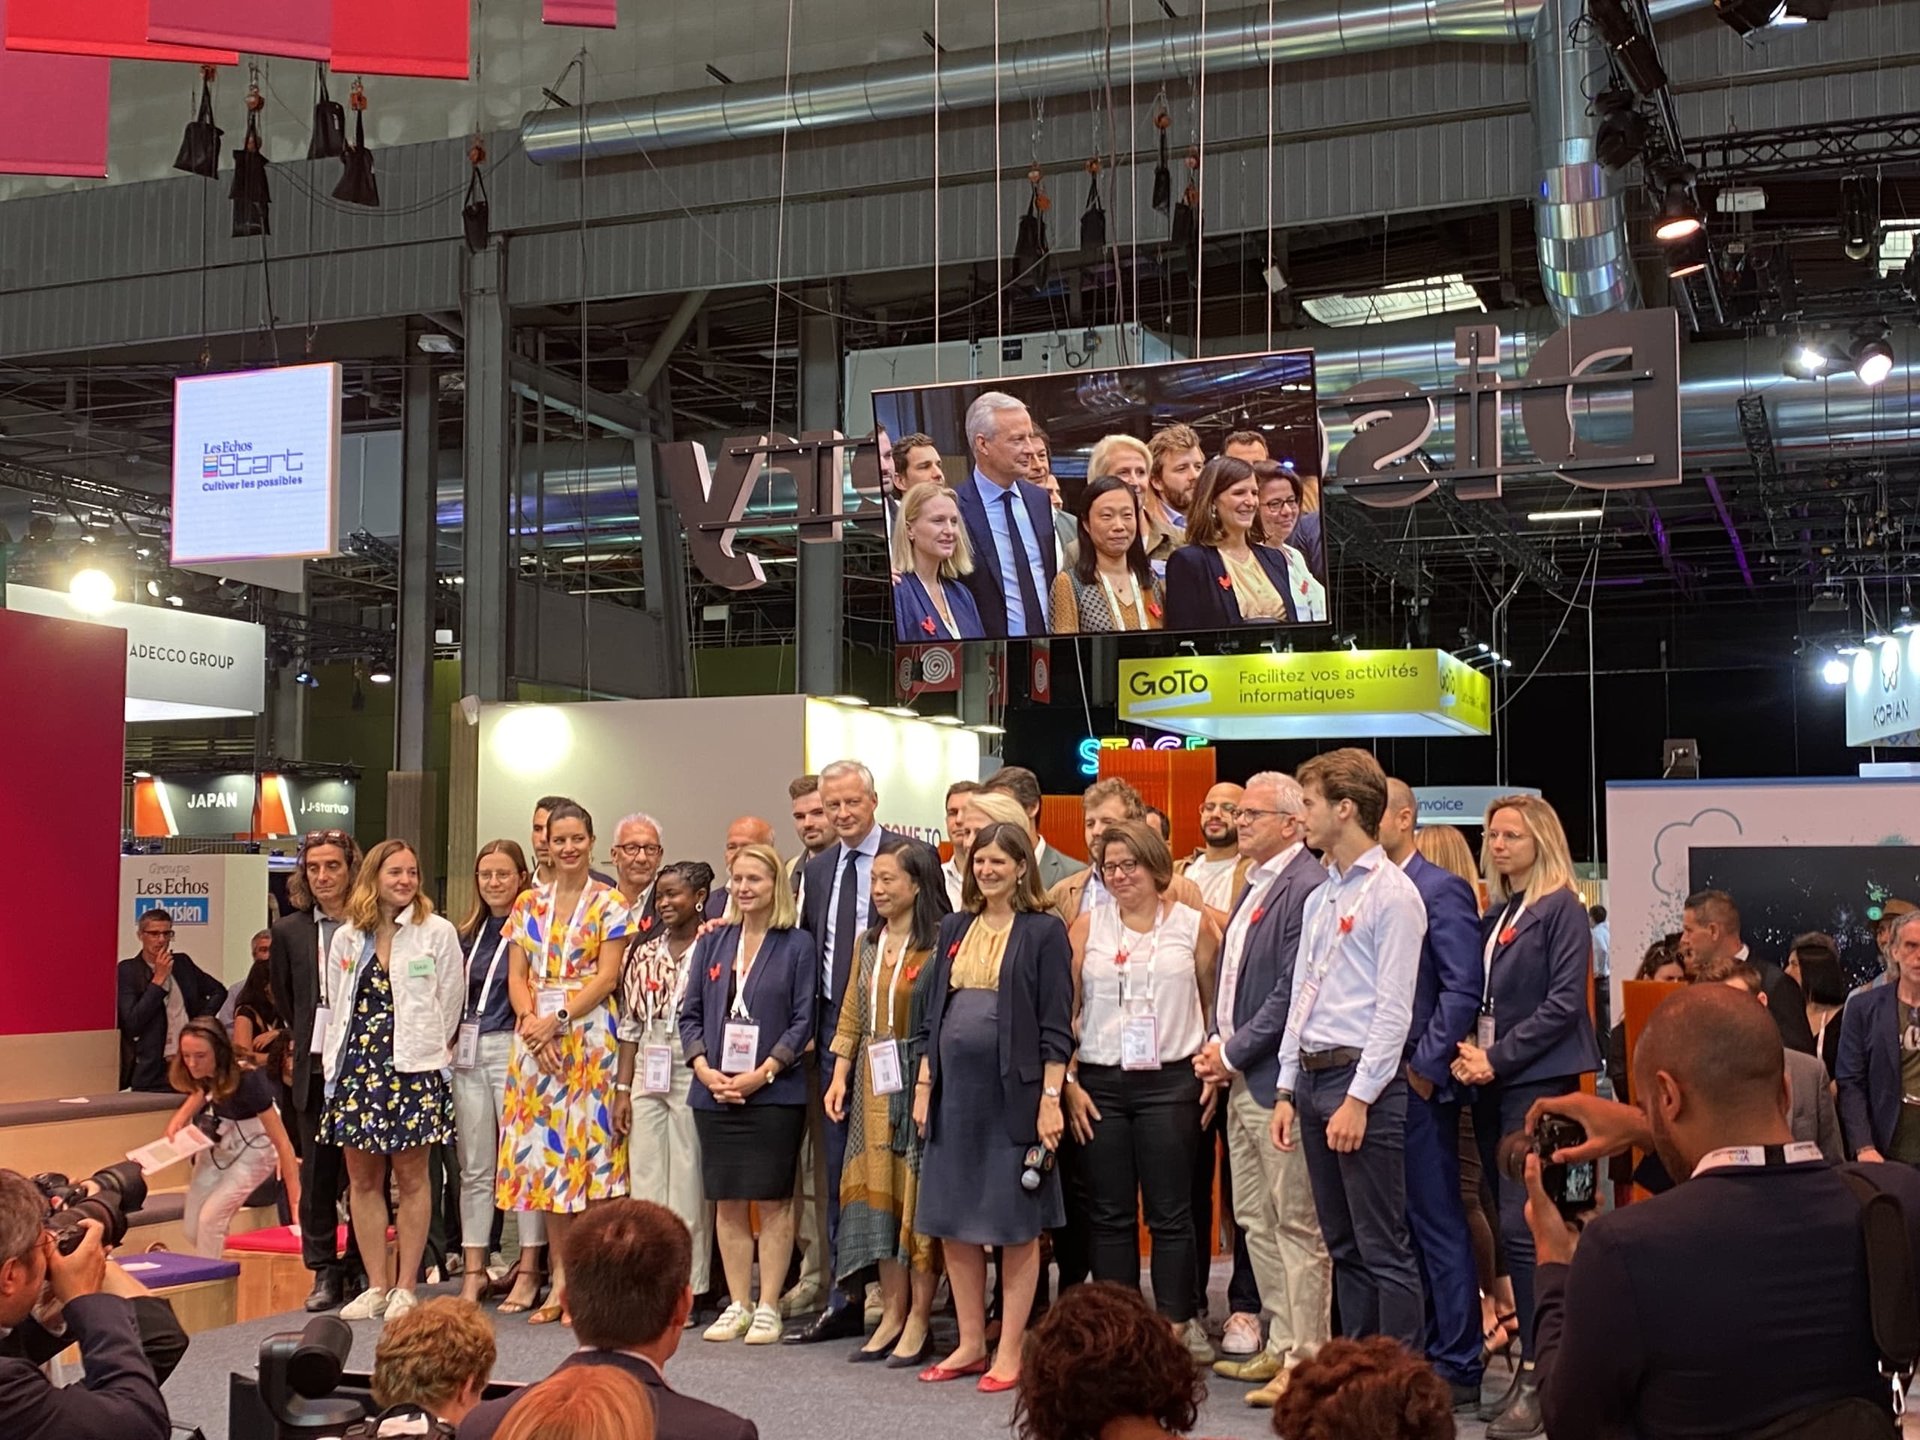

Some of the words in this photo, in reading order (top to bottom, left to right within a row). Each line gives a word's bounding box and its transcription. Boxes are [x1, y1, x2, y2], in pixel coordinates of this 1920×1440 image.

[203, 443, 221, 454] Les
[222, 440, 252, 453] Echos
[219, 448, 303, 477] Start
[202, 480, 240, 491] Cultiver
[241, 480, 255, 489] les
[257, 476, 303, 489] possibles
[129, 644, 186, 663] ADECCO
[189, 652, 234, 669] GROUP
[1239, 671, 1305, 684] Facilitez
[1311, 670, 1340, 681] vos
[1345, 663, 1418, 680] activités
[1129, 670, 1208, 696] GoTo
[1239, 687, 1355, 703] informatiques
[1872, 699, 1909, 728] KORIAN
[187, 792, 238, 809] JAPAN
[307, 802, 349, 815] J-Startup
[149, 863, 191, 877] Groupe
[136, 879, 162, 895] Les
[164, 877, 209, 895] Echos
